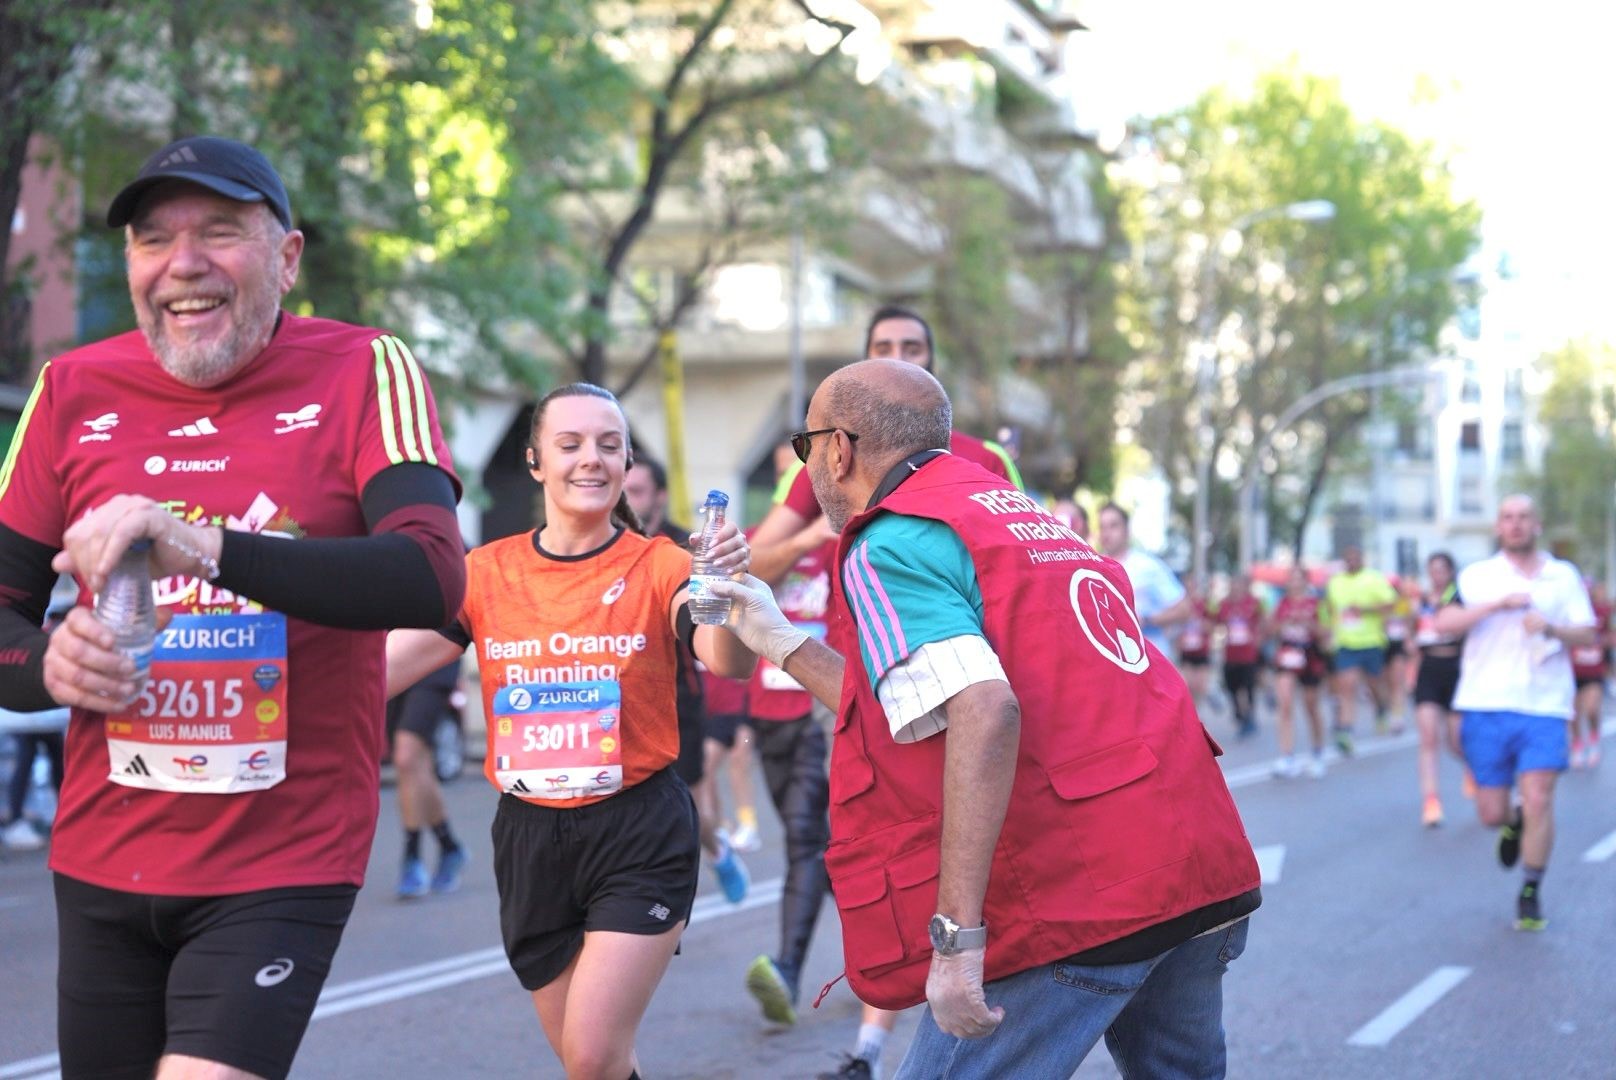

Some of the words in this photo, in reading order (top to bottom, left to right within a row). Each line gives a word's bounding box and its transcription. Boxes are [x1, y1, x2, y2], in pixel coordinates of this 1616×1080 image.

[170, 459, 226, 472] ZURICH
[161, 628, 256, 649] ZURICH
[484, 637, 542, 661] Team
[549, 632, 647, 659] Orange
[505, 661, 616, 686] Running
[139, 678, 244, 719] 52615
[538, 688, 600, 705] ZURICH
[148, 723, 176, 740] LUIS
[178, 724, 233, 741] MANUEL
[522, 723, 590, 752] 53011
